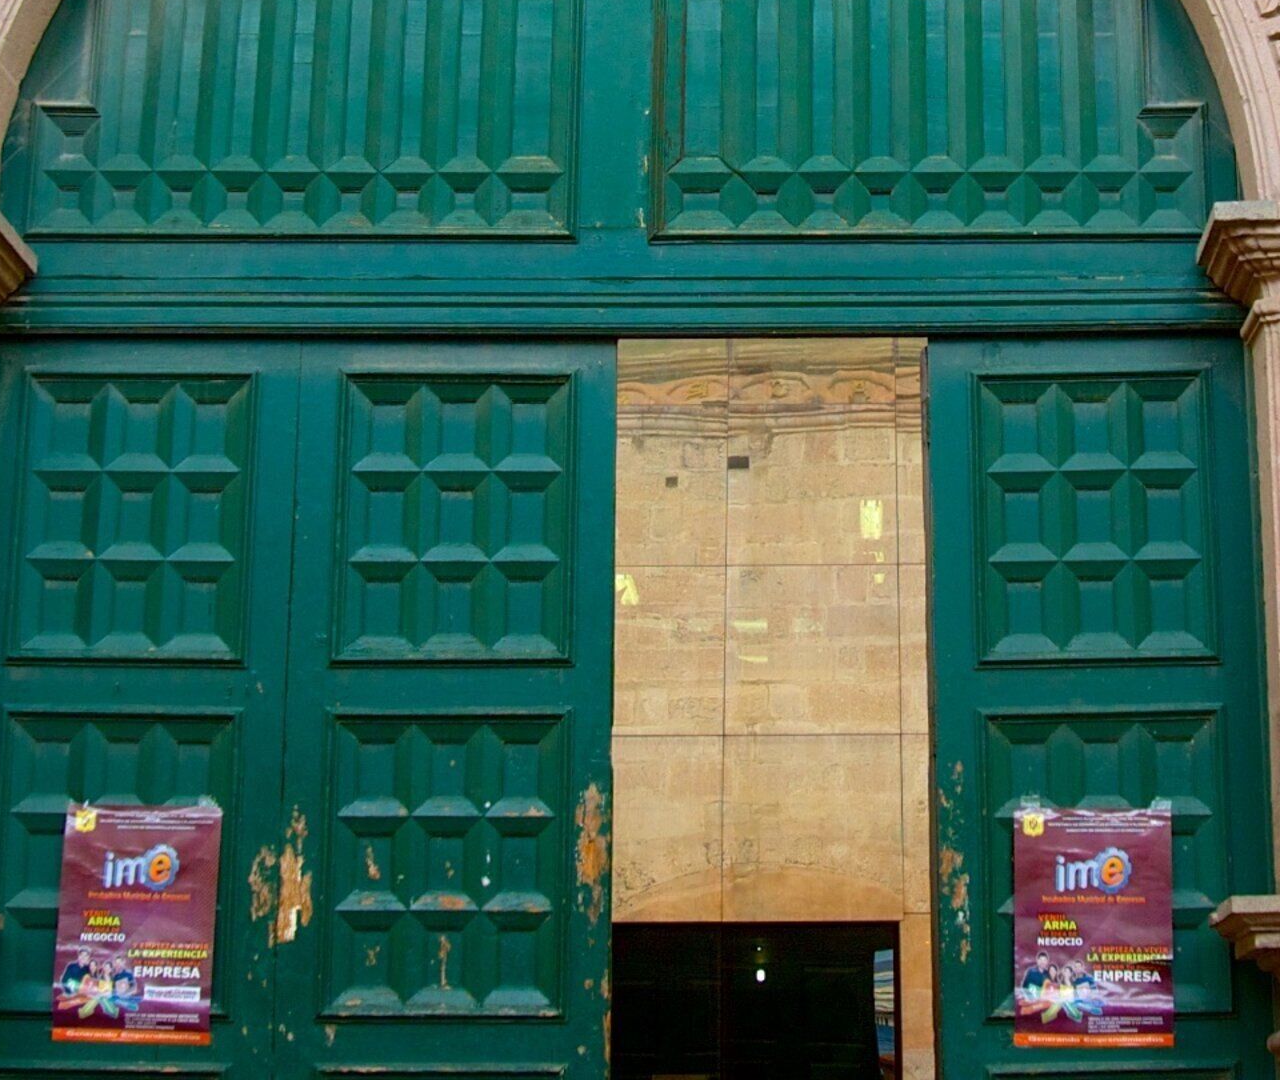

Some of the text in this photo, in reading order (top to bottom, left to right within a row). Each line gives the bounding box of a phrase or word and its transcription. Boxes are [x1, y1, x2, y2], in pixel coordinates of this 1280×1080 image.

[103, 850, 173, 889] ime
[1055, 854, 1125, 893] ime
[87, 916, 120, 926] ARMA
[1043, 920, 1077, 930] ARMA
[80, 932, 126, 942] NEGOCIO
[1036, 936, 1083, 946] NEGOCIO
[127, 949, 208, 959] LA EXPERIENCIA
[1086, 953, 1099, 961] LA
[134, 966, 200, 979] EMPRESA
[1094, 970, 1162, 982] EMPRESA
